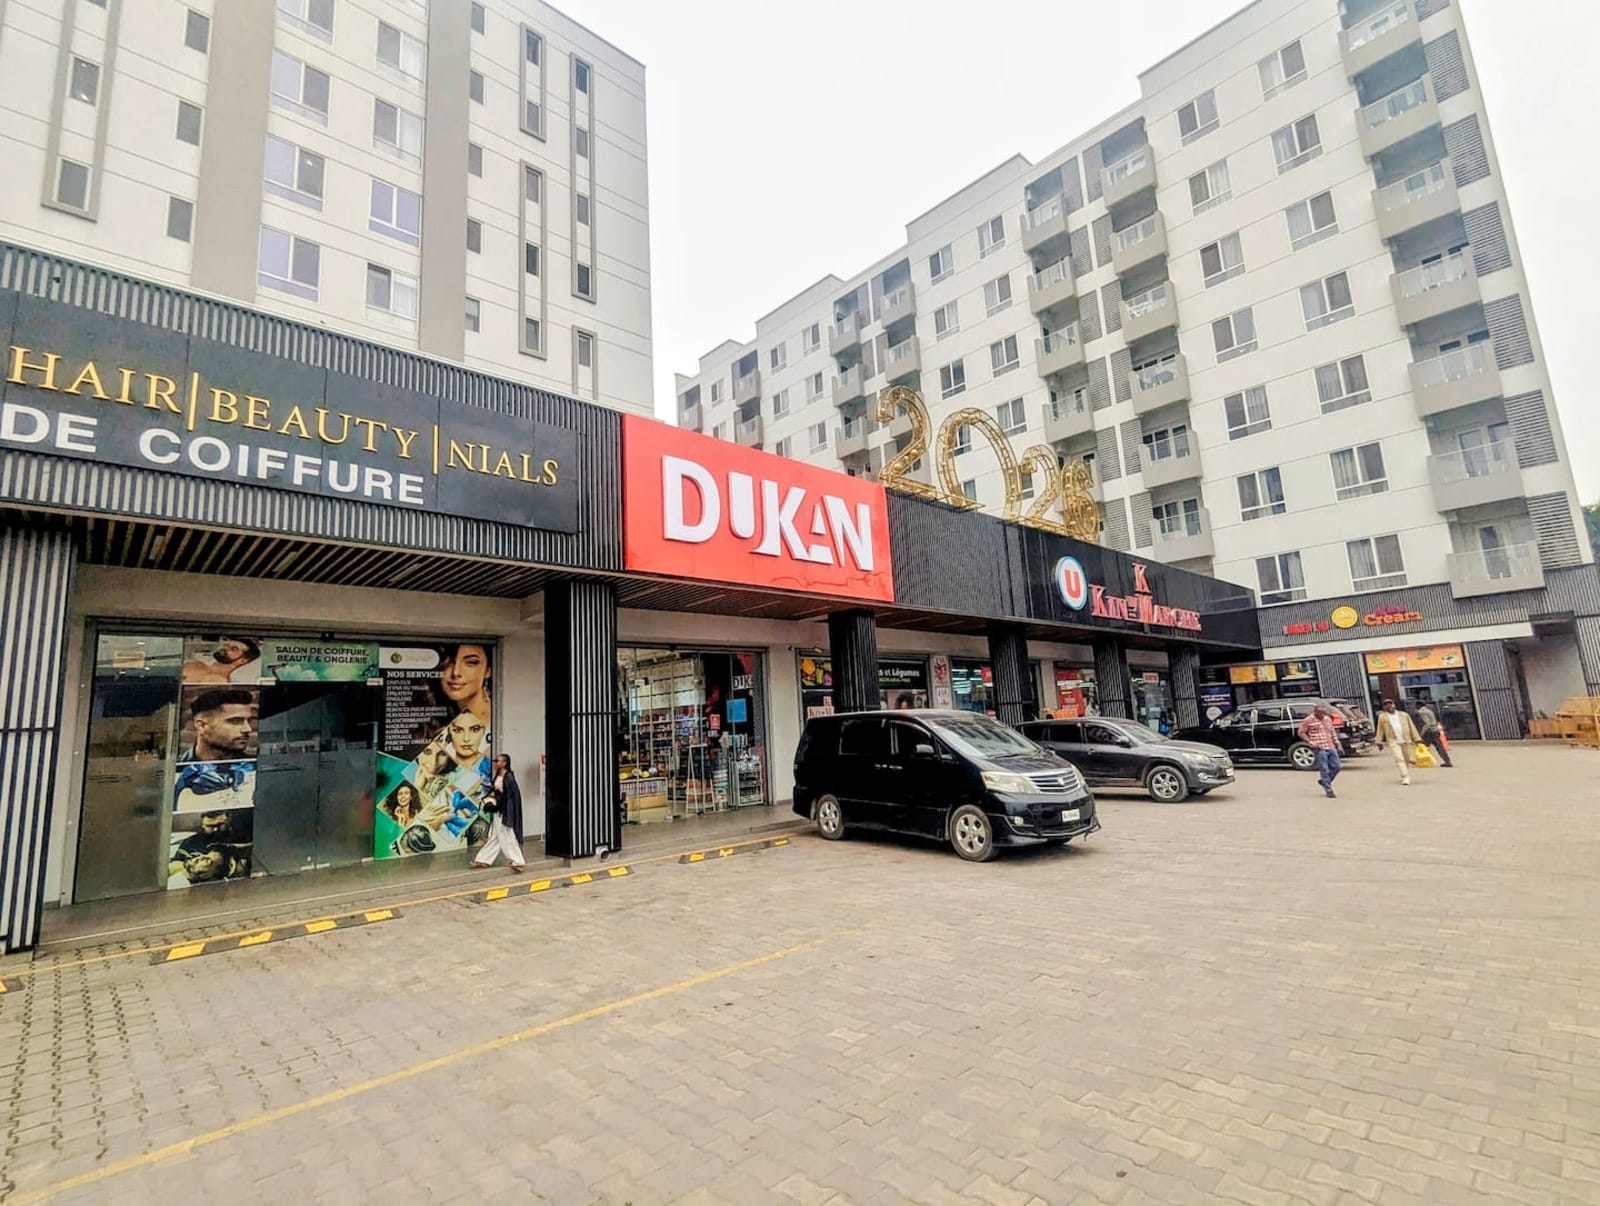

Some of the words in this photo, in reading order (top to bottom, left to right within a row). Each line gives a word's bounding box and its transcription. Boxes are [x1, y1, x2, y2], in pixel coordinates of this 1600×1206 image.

[7, 346, 183, 414] HAIR
[207, 387, 419, 459] BEAUTY
[446, 439, 560, 487] NIALS
[0, 404, 99, 454] DE
[138, 428, 426, 505] COIFFURE
[877, 385, 1099, 543] 2026
[661, 454, 874, 572] DUKAN
[1064, 569, 1081, 598] U
[1364, 611, 1422, 626] Cream
[275, 646, 307, 654] SALON
[309, 647, 322, 655] DE
[323, 655, 368, 664] ONGLERIE
[406, 671, 445, 679] SERVICES
[892, 667, 920, 678] Légumes
